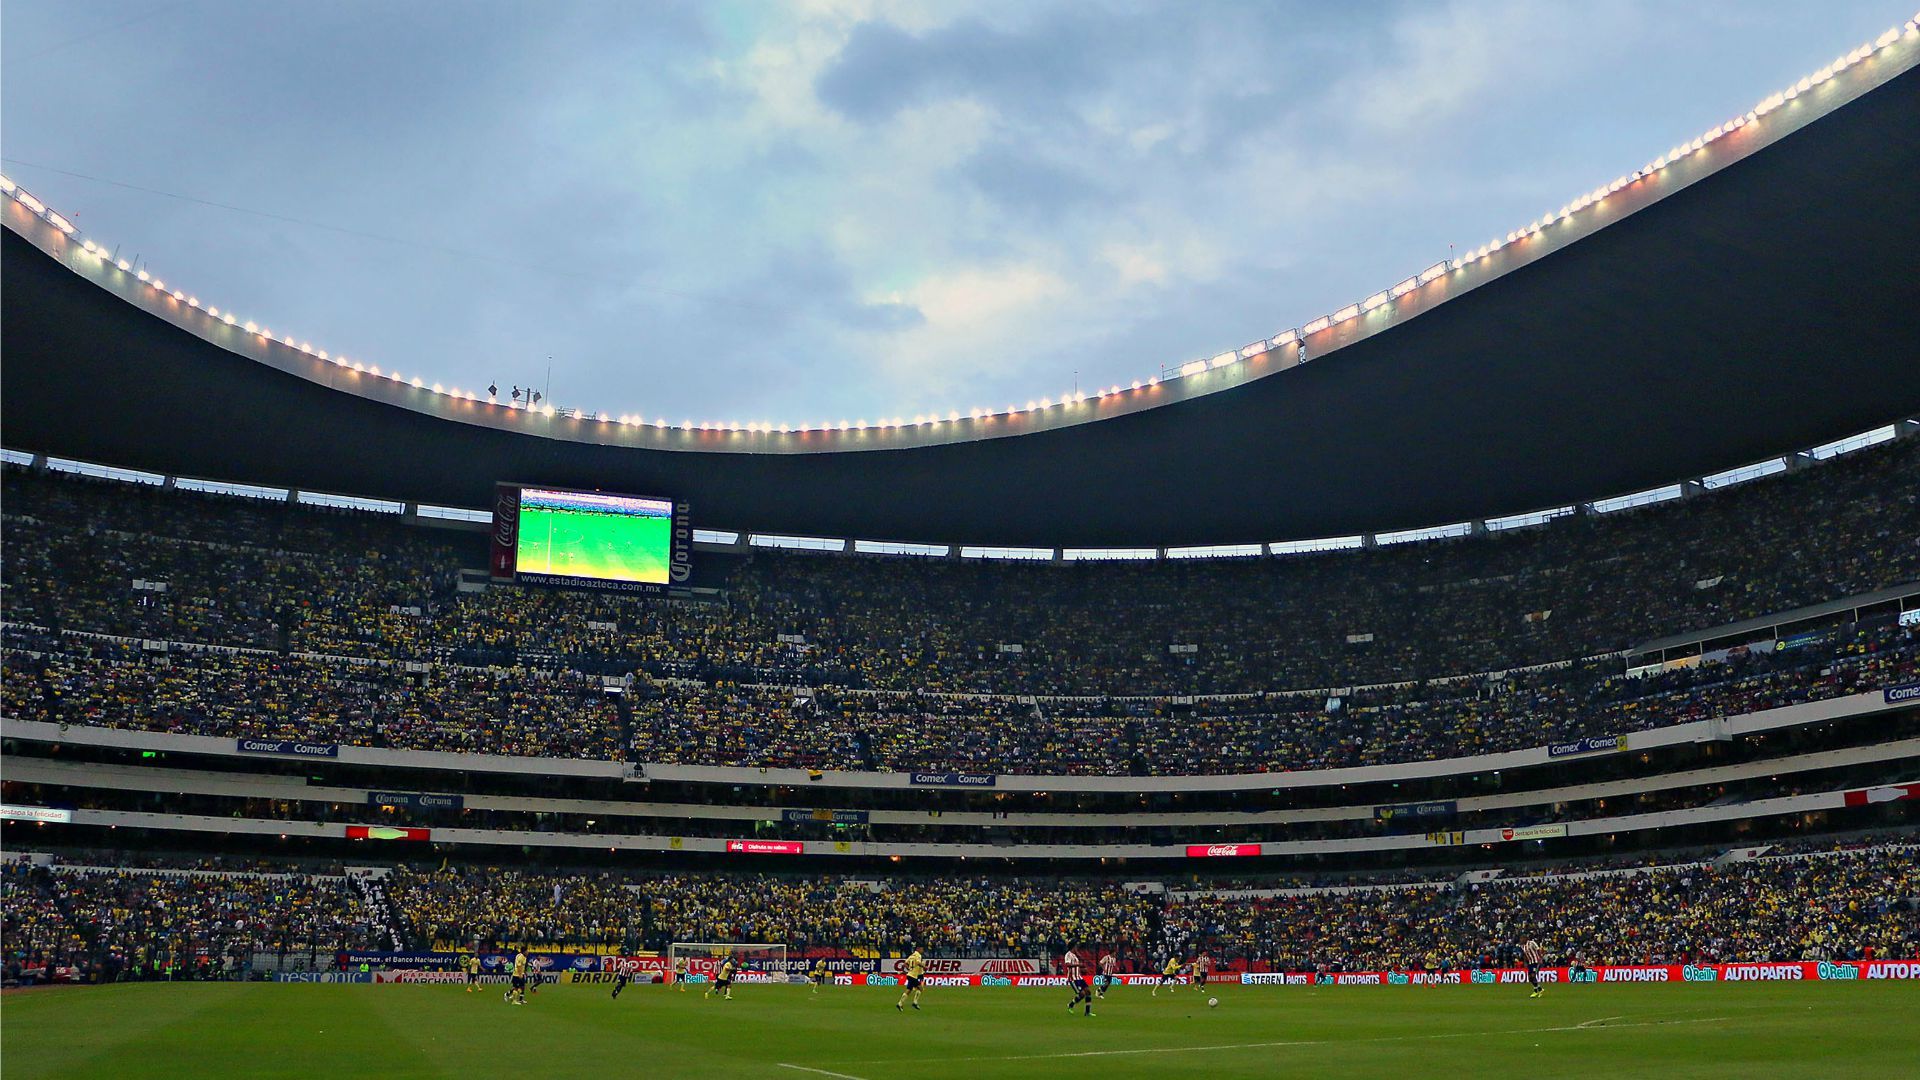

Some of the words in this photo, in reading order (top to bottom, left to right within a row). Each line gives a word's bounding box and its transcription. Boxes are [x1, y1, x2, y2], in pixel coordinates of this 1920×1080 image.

[670, 501, 692, 582] Corona
[521, 574, 661, 593] www.estadioazteca.com.mx
[1889, 687, 1920, 700] Come
[243, 740, 282, 752] Comex
[294, 744, 332, 755] Comex
[1552, 742, 1580, 755] Comex
[1589, 737, 1617, 749] Comex
[915, 774, 949, 784] Comex
[958, 775, 990, 784] Comex
[375, 793, 409, 804] Corona
[419, 795, 452, 806] Corona
[789, 811, 813, 821] Coro
[617, 958, 671, 969] OTAL
[894, 960, 961, 971] GHER
[1471, 968, 1496, 983] O'Reilly
[1501, 972, 1526, 982] AUTO
[1604, 969, 1633, 981] AUTO
[1633, 968, 1668, 981] PARTS
[1683, 964, 1717, 981] O'Reilly
[1725, 967, 1760, 980] AUTO
[1760, 965, 1803, 980] PARTS
[1817, 961, 1859, 979] O'Reilly
[1867, 963, 1909, 979] AUTO
[477, 973, 512, 984] mway
[935, 976, 970, 985] PARTS
[1017, 977, 1048, 985] AUTO
[1128, 976, 1156, 984] AUTO
[1251, 974, 1282, 984] STEREN
[1286, 975, 1307, 984] PARTS
[1338, 974, 1357, 984] AUTO
[1357, 974, 1380, 984] PARTS
